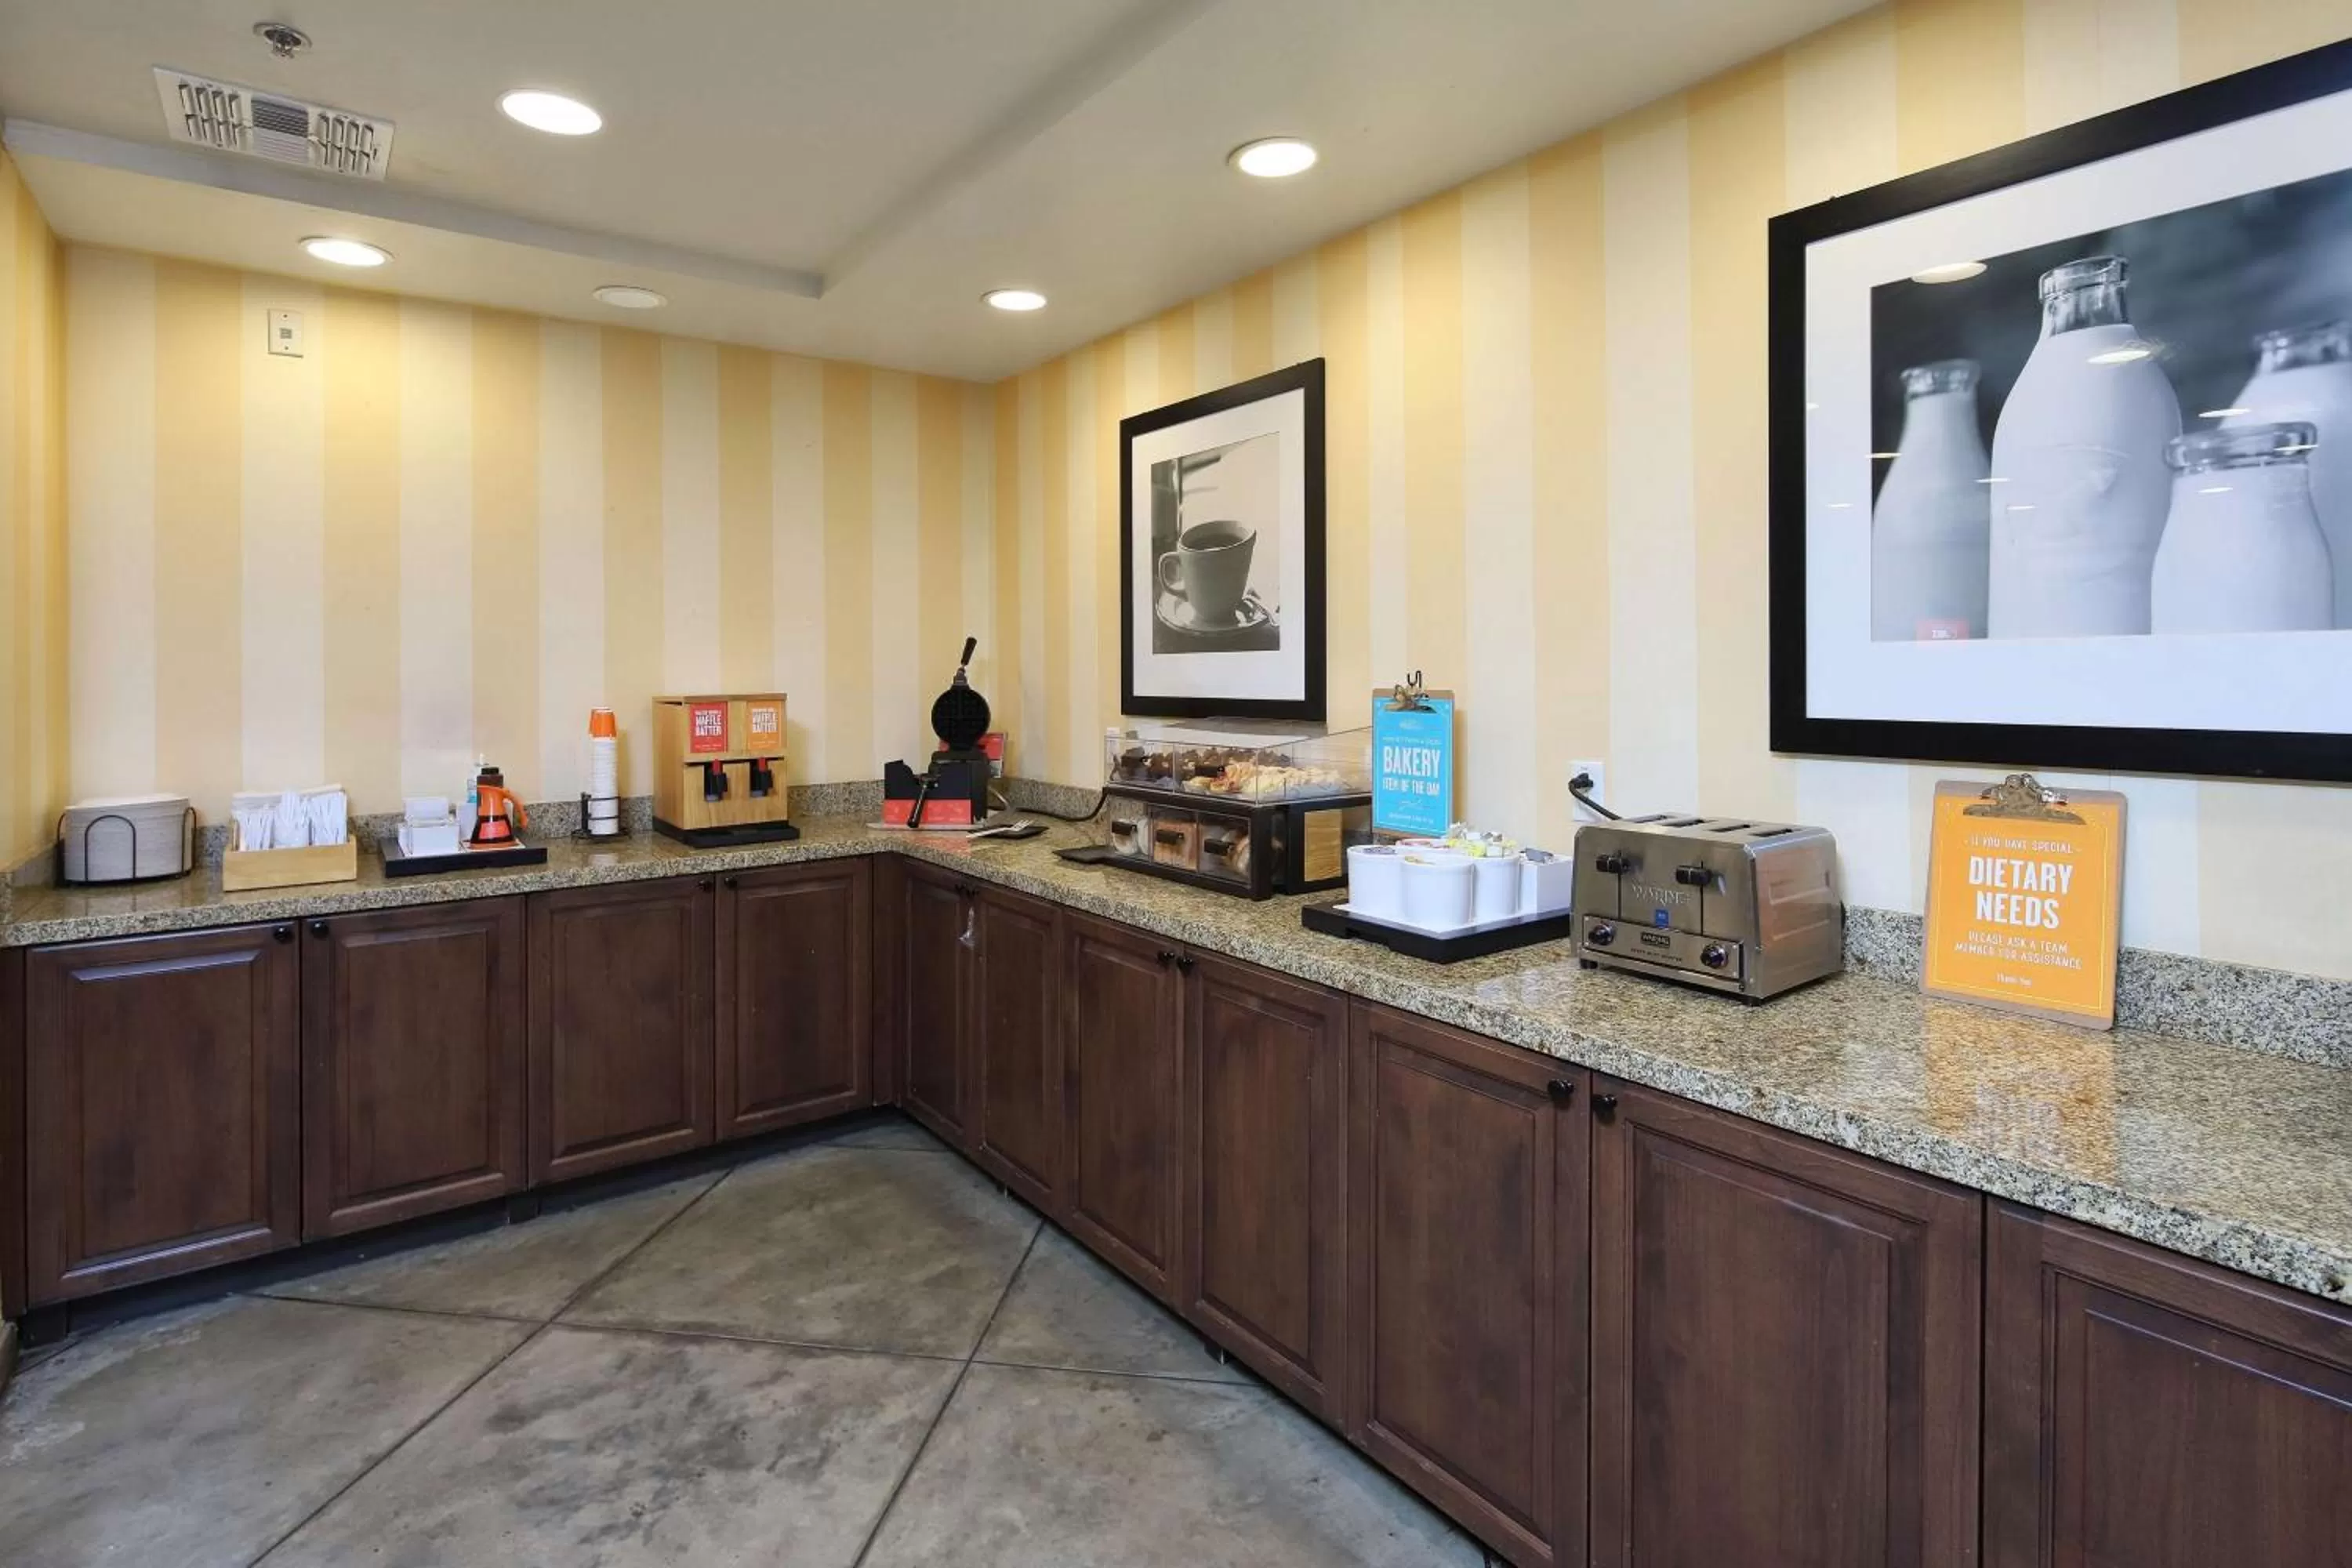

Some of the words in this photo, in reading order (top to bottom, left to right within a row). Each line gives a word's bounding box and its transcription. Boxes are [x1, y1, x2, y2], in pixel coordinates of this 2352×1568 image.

[1383, 746, 1441, 779] BAKERY
[2031, 840, 2074, 854] SPECIAL
[1969, 855, 2074, 895] DIETARY
[1976, 890, 2060, 929] NEEDS
[1954, 942, 1995, 956] MEMBER
[1999, 948, 2017, 960] FOR
[2020, 951, 2083, 970] ASSISTANCE
[1969, 931, 2003, 946] PLEASE
[2007, 936, 2027, 948] ASK
[2030, 940, 2036, 951] A
[2041, 940, 2068, 954] TEAM
